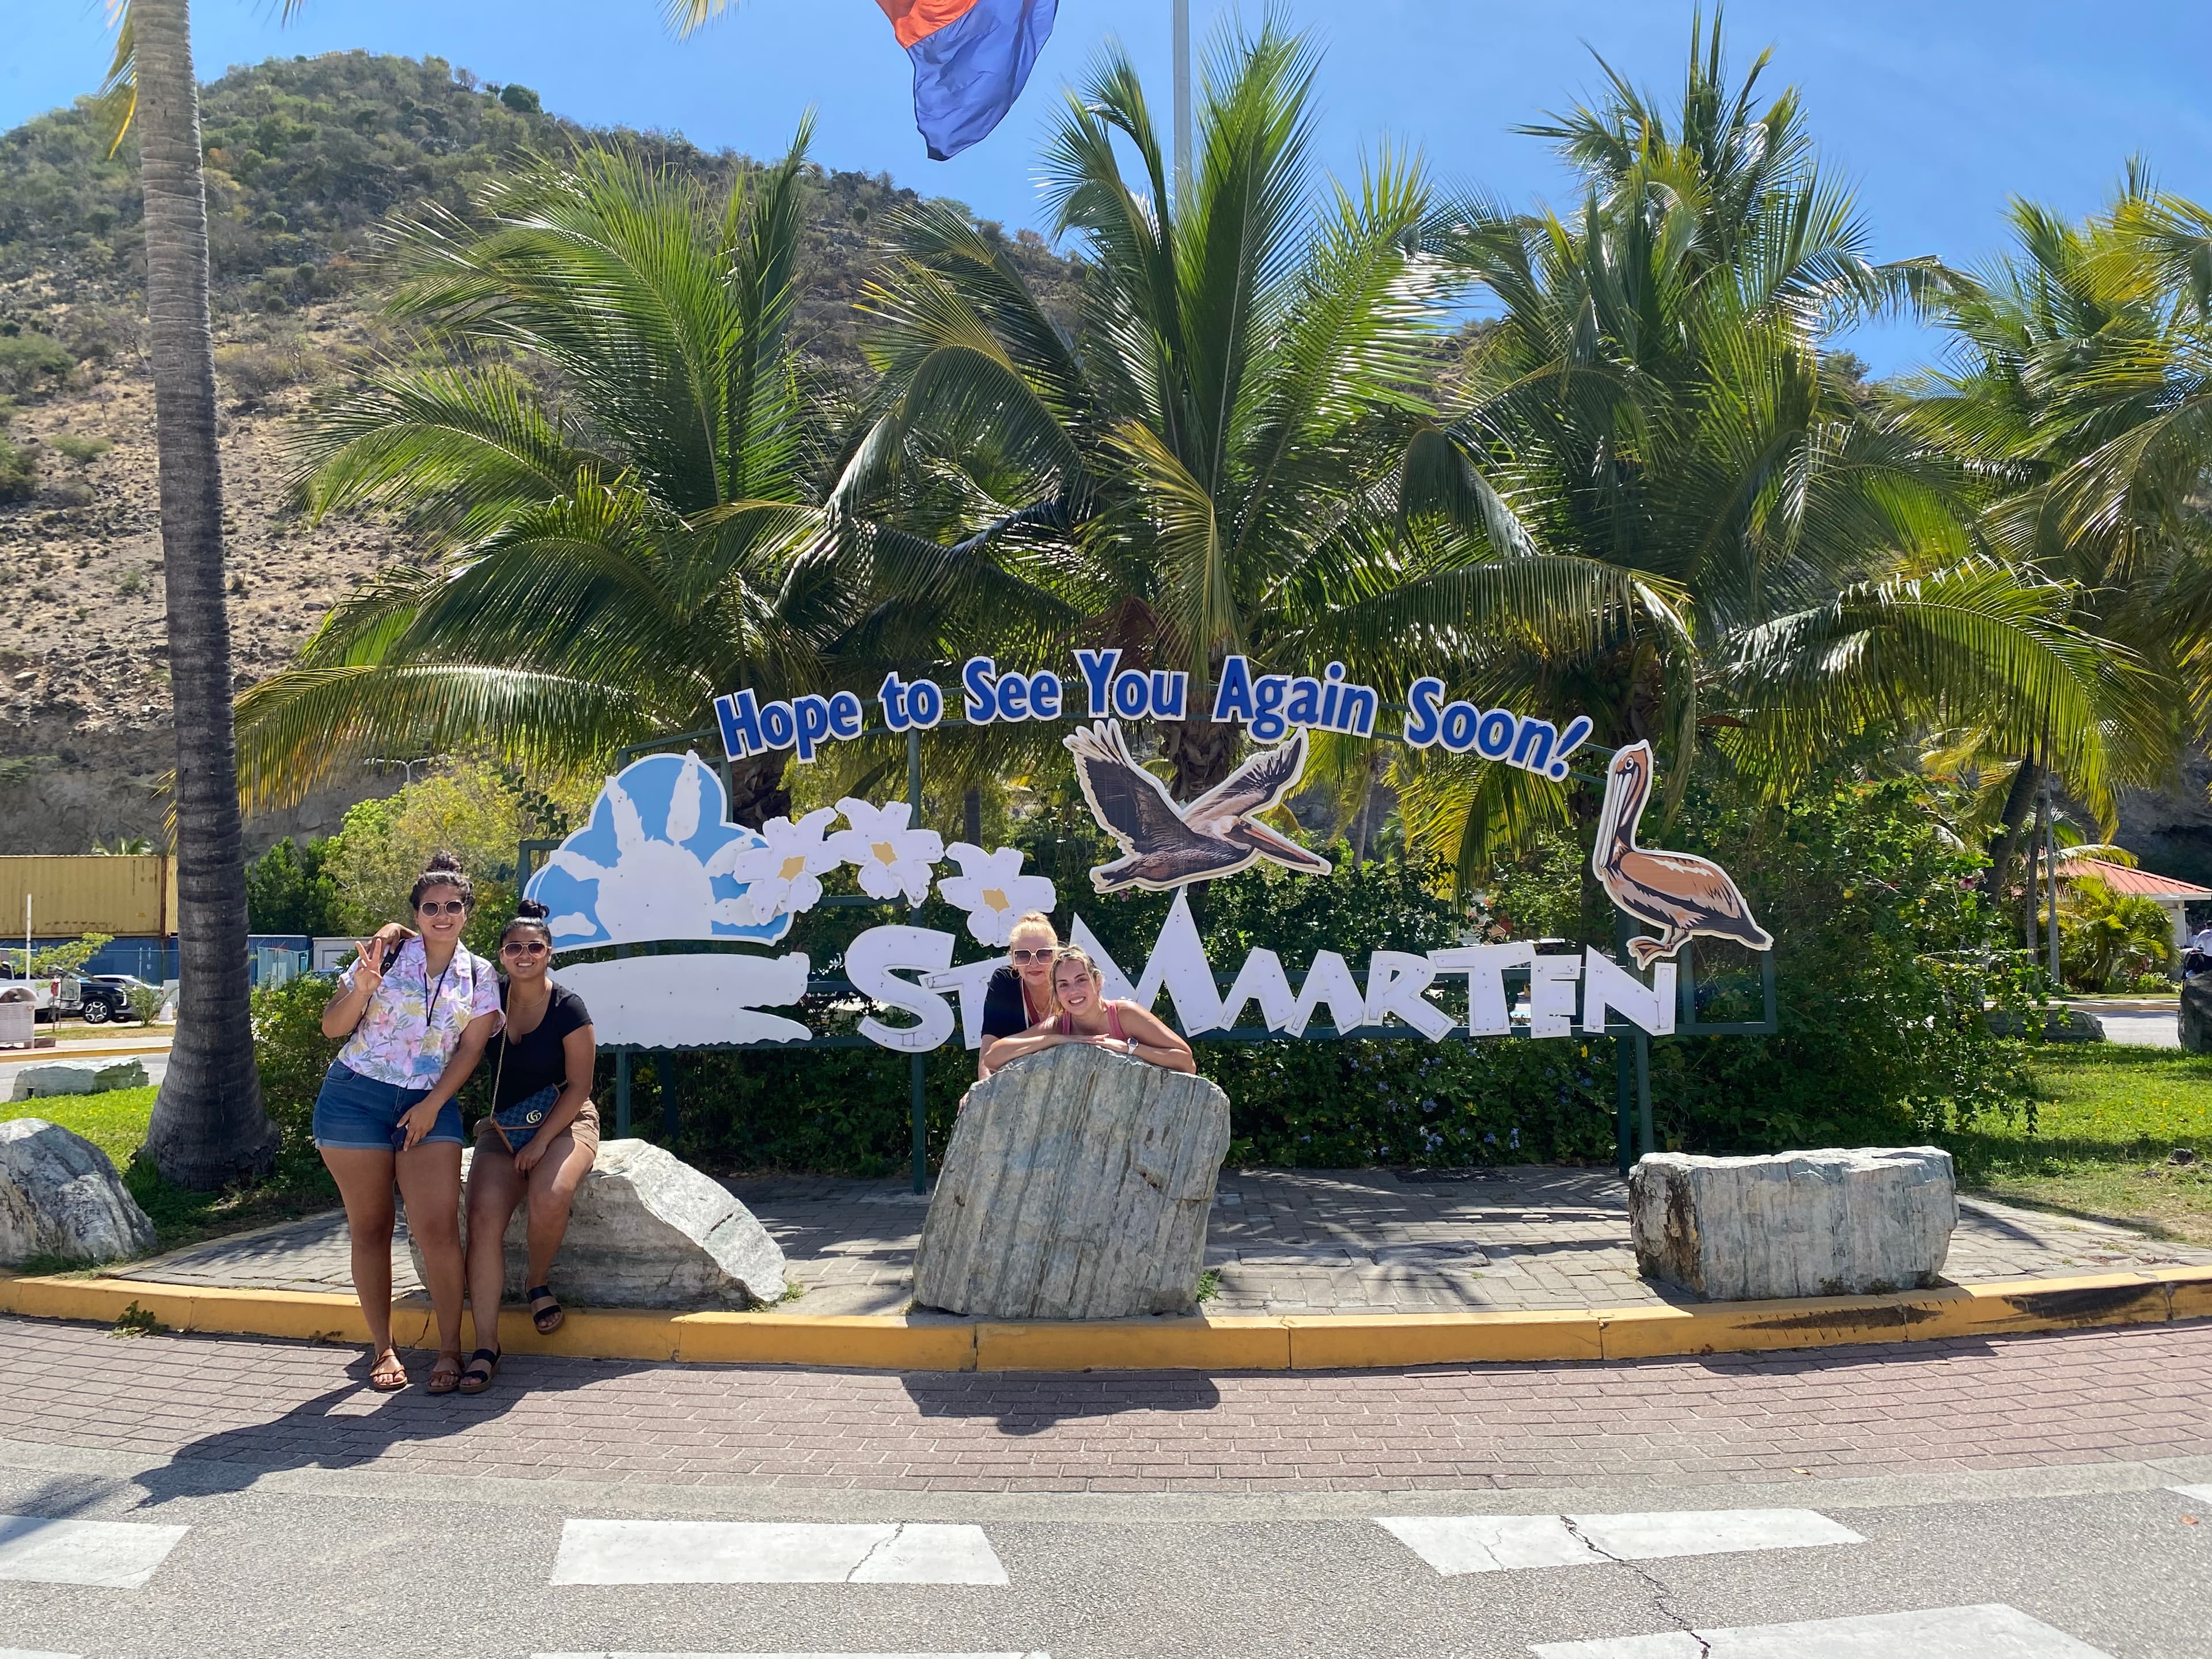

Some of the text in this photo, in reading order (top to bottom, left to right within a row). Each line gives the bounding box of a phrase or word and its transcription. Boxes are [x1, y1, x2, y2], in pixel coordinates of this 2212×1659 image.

[713, 649, 1594, 782] Hope to See You Again Soon!
